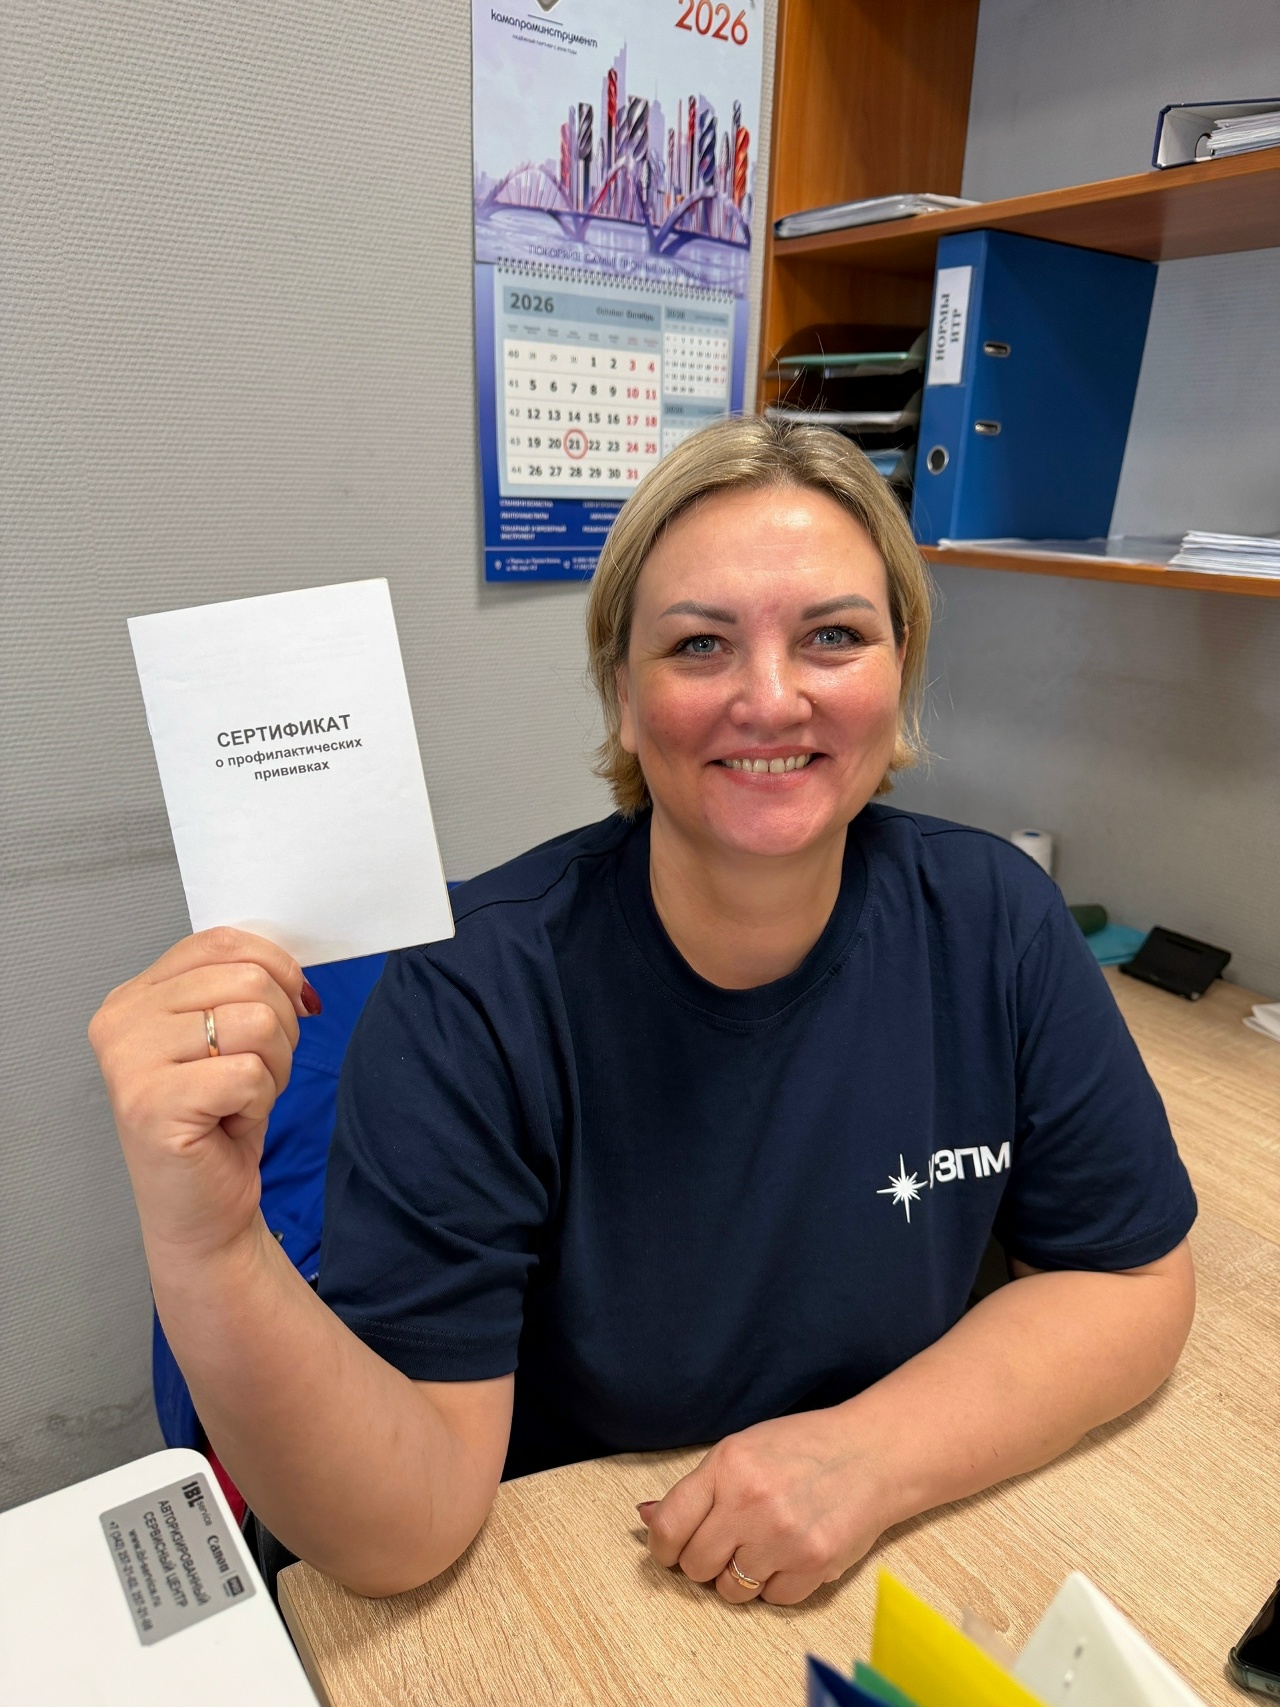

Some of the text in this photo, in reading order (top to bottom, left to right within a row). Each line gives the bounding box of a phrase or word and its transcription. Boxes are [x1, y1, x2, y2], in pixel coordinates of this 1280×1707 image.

[490, 9, 598, 48] камапроминструмент
[675, 0, 748, 46] 2026
[510, 292, 555, 313] 2026
[936, 294, 949, 360] НОРМЫ
[591, 356, 597, 367] 1
[611, 358, 617, 369] 2
[629, 360, 636, 371] 3
[648, 362, 655, 373] 4
[529, 380, 537, 391] 5
[550, 381, 557, 392] 6
[571, 382, 577, 394] 7
[590, 384, 597, 396] 8
[610, 385, 617, 397] 9
[627, 387, 639, 399] 10
[645, 389, 657, 401] 11
[528, 408, 541, 420] 12
[548, 410, 561, 421] 13
[568, 411, 581, 422] 14
[588, 412, 600, 423] 15
[608, 414, 620, 425] 16
[626, 415, 639, 426] 17
[645, 415, 657, 427] 18
[528, 437, 541, 449] 19
[548, 438, 561, 449] 20
[568, 438, 580, 450] 21
[588, 439, 601, 451] 22
[608, 441, 620, 452] 23
[626, 442, 639, 453] 24
[645, 443, 657, 454] 25
[529, 465, 542, 476] 26
[549, 466, 562, 477] 27
[569, 467, 582, 478] 28
[589, 467, 602, 478] 29
[608, 468, 621, 479] 30
[626, 468, 638, 480] 31
[217, 714, 351, 748] СЕРТИФИКАТ
[215, 738, 363, 768] о профилактических
[254, 760, 330, 781] прививках
[143, 1511, 188, 1607] СЕРВИСНЫЙ ЦЕНТР
[159, 1500, 211, 1606] АВТОРИЗИРОВАННЫЙ
[207, 1535, 230, 1573] Canon
